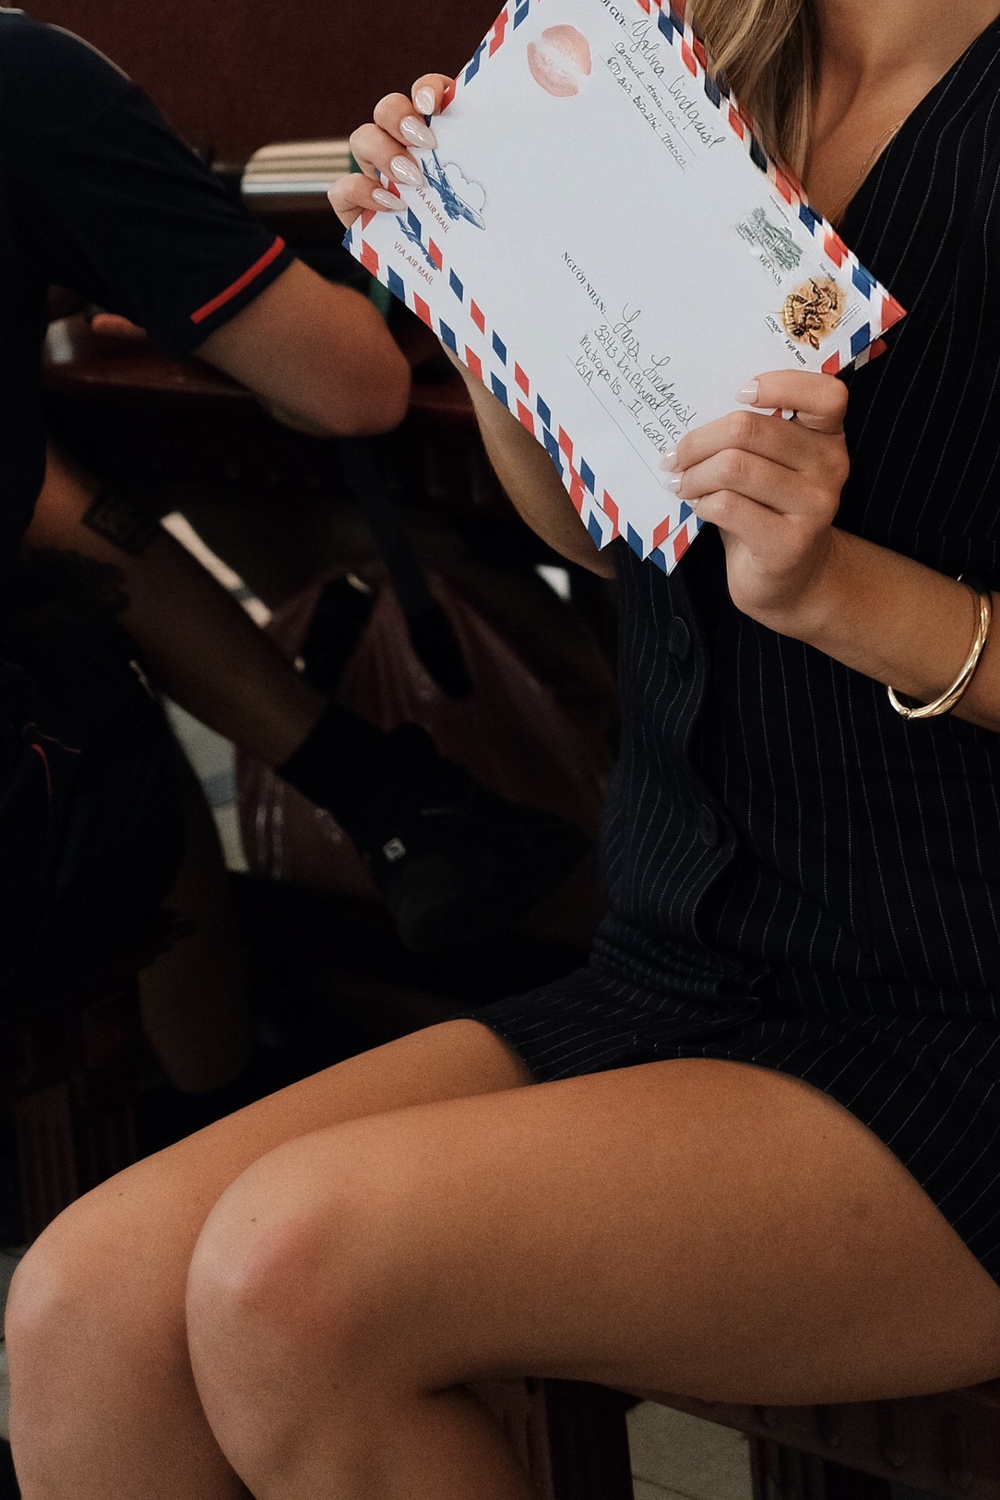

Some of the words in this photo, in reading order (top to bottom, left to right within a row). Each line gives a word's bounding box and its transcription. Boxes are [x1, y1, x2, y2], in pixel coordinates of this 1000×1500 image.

[414, 185, 426, 201] VIA
[424, 200, 437, 215] AIR
[434, 212, 450, 234] MAIL
[394, 240, 406, 257] VIA
[405, 255, 419, 269] AIR
[416, 266, 434, 286] MAIL
[560, 251, 588, 285] NGƯỜI
[768, 267, 783, 285] NAM
[593, 325, 619, 359] 3243
[615, 353, 664, 413] Driftwood
[792, 350, 808, 366] Nam
